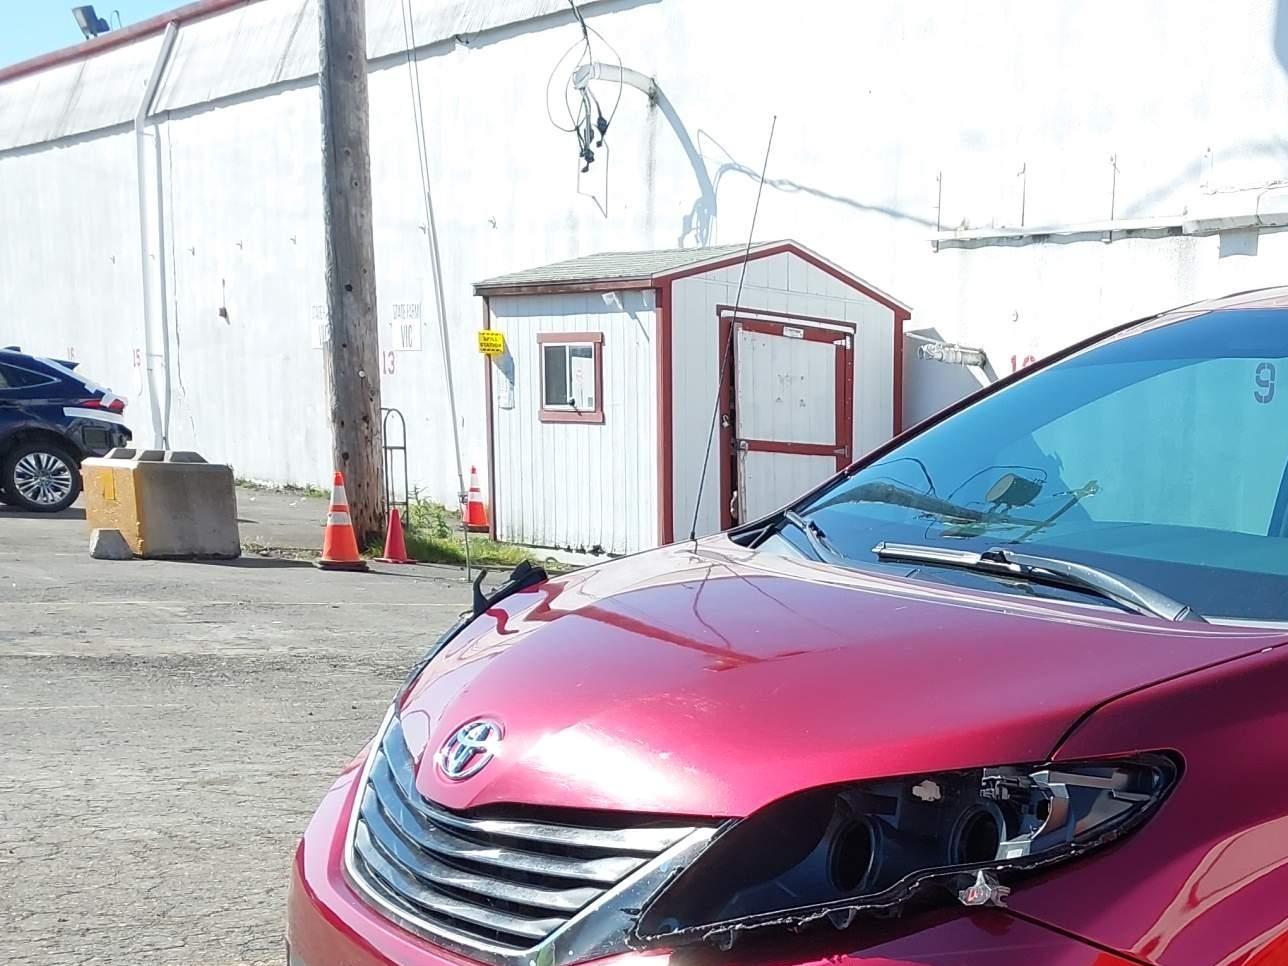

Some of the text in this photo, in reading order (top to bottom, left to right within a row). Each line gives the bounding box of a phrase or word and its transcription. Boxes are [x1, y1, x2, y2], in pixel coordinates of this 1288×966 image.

[400, 324, 412, 348] VIC
[133, 348, 140, 368] 15
[382, 350, 395, 375] 13
[1254, 362, 1276, 404] 9
